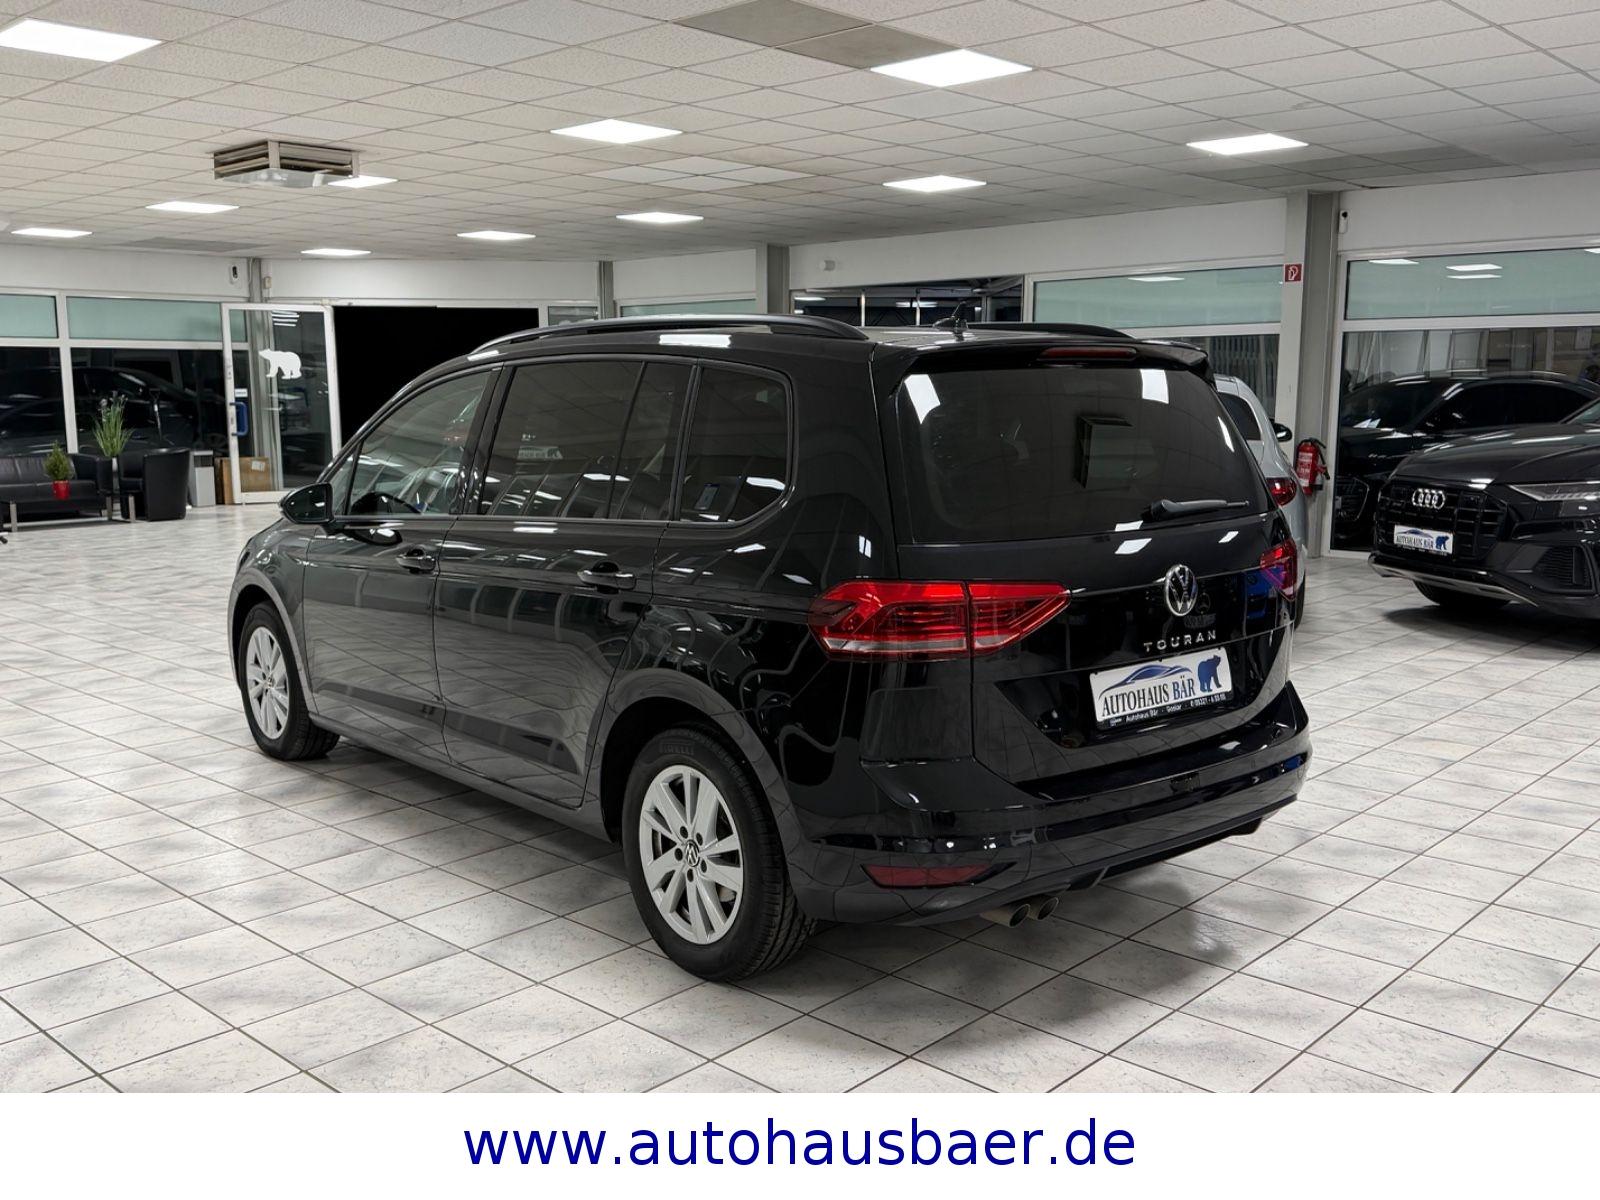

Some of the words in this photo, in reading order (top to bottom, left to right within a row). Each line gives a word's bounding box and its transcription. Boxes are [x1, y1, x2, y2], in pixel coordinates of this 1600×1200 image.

[1143, 630, 1217, 652] TOURAN
[1101, 684, 1170, 717] AUTOHAUS
[1172, 675, 1196, 700] BÄR
